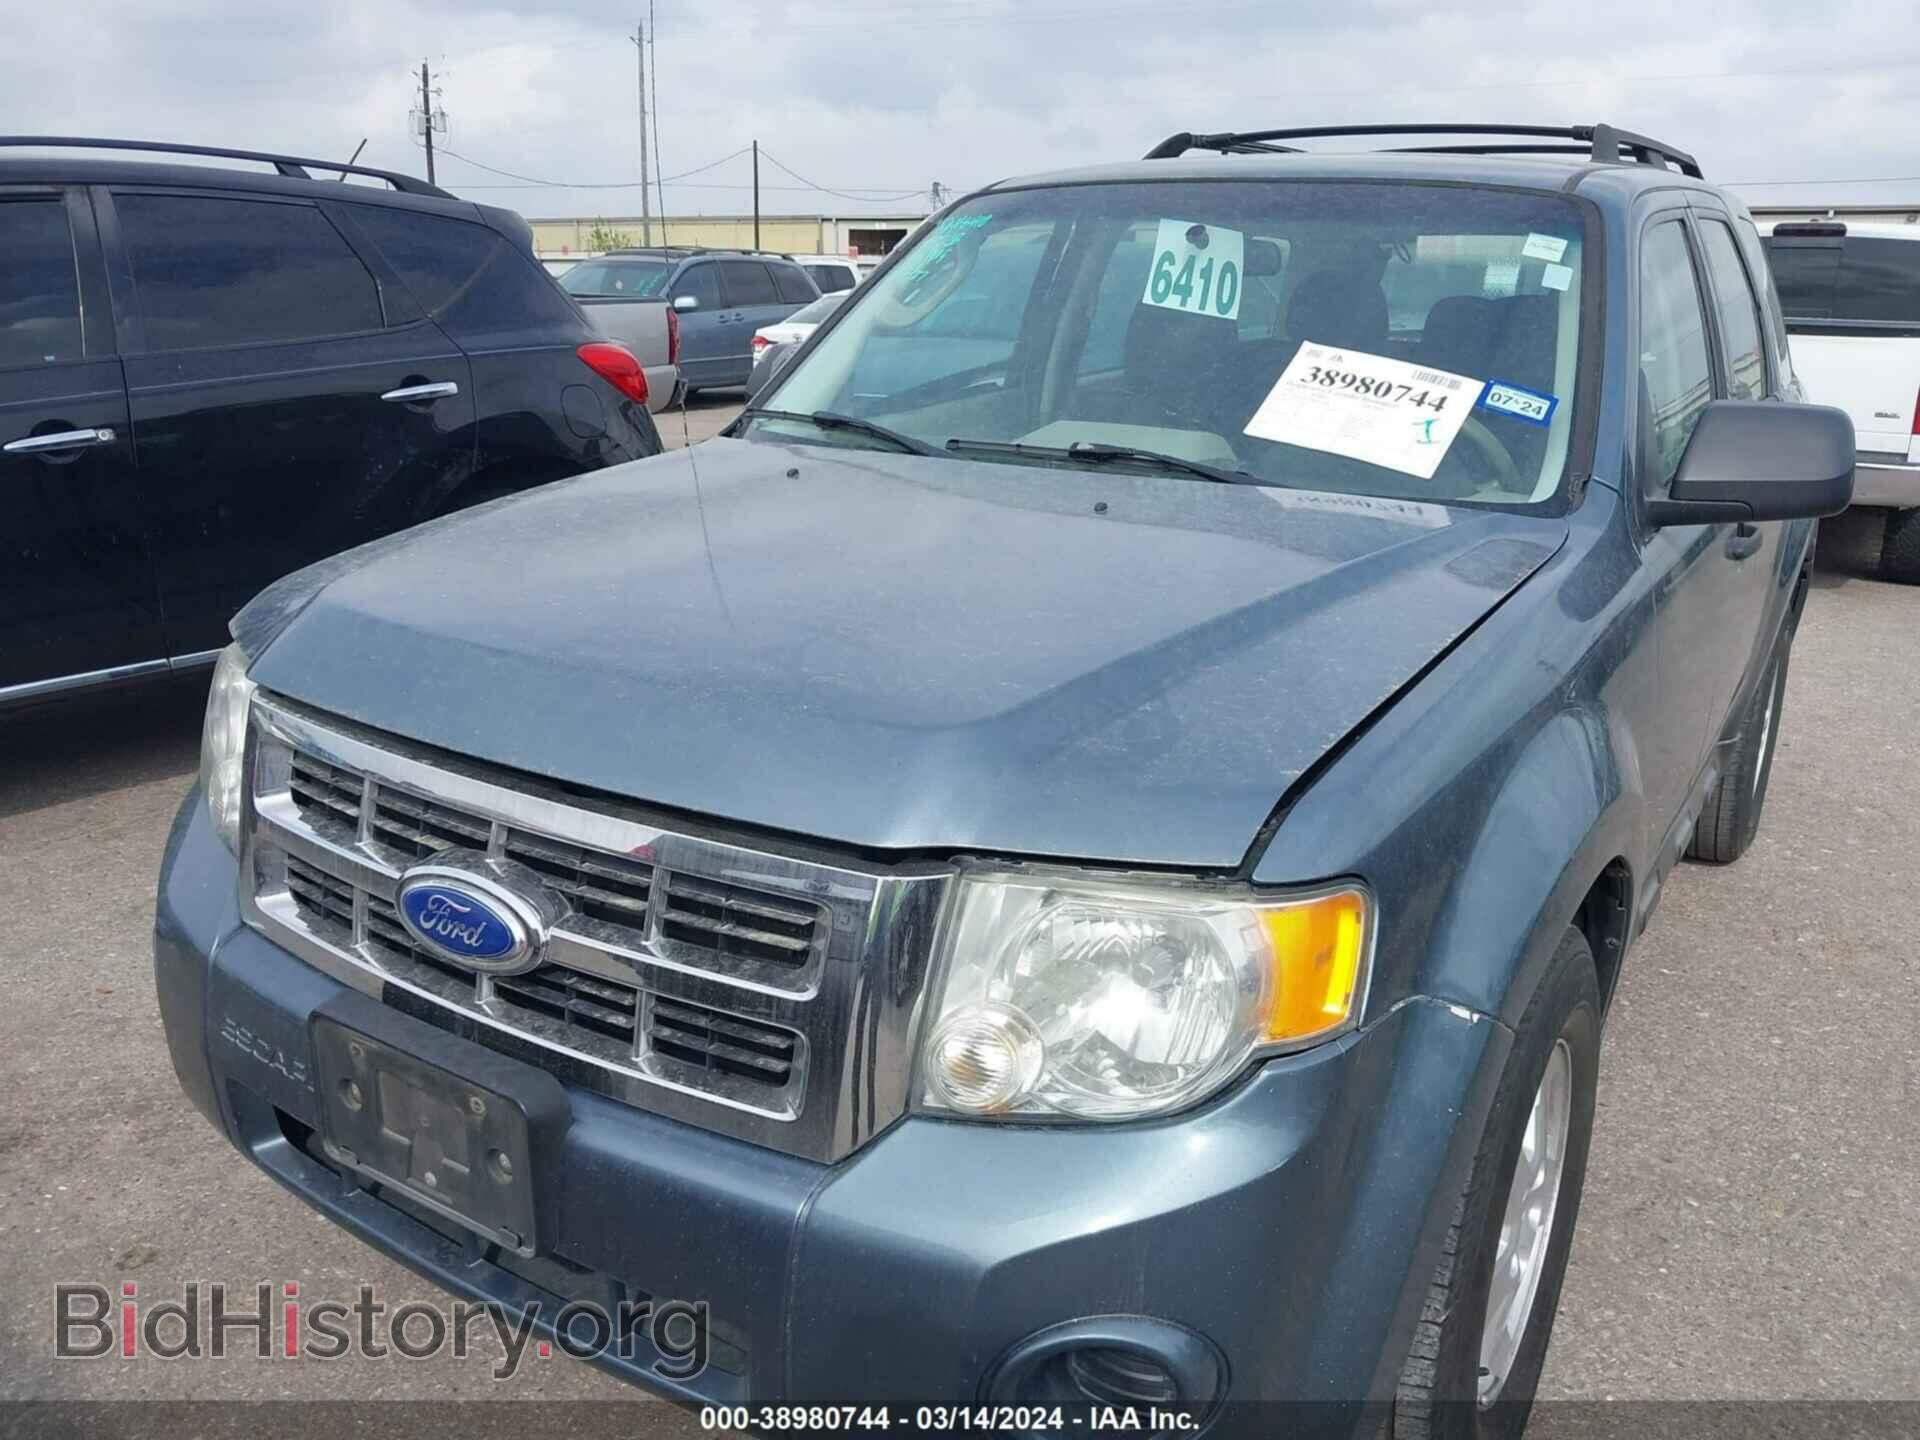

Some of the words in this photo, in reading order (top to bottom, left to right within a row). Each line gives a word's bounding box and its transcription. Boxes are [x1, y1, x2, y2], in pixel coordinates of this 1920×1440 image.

[1151, 250, 1238, 316] 6410
[1300, 366, 1449, 413] 38980744
[420, 895, 485, 947] Ford
